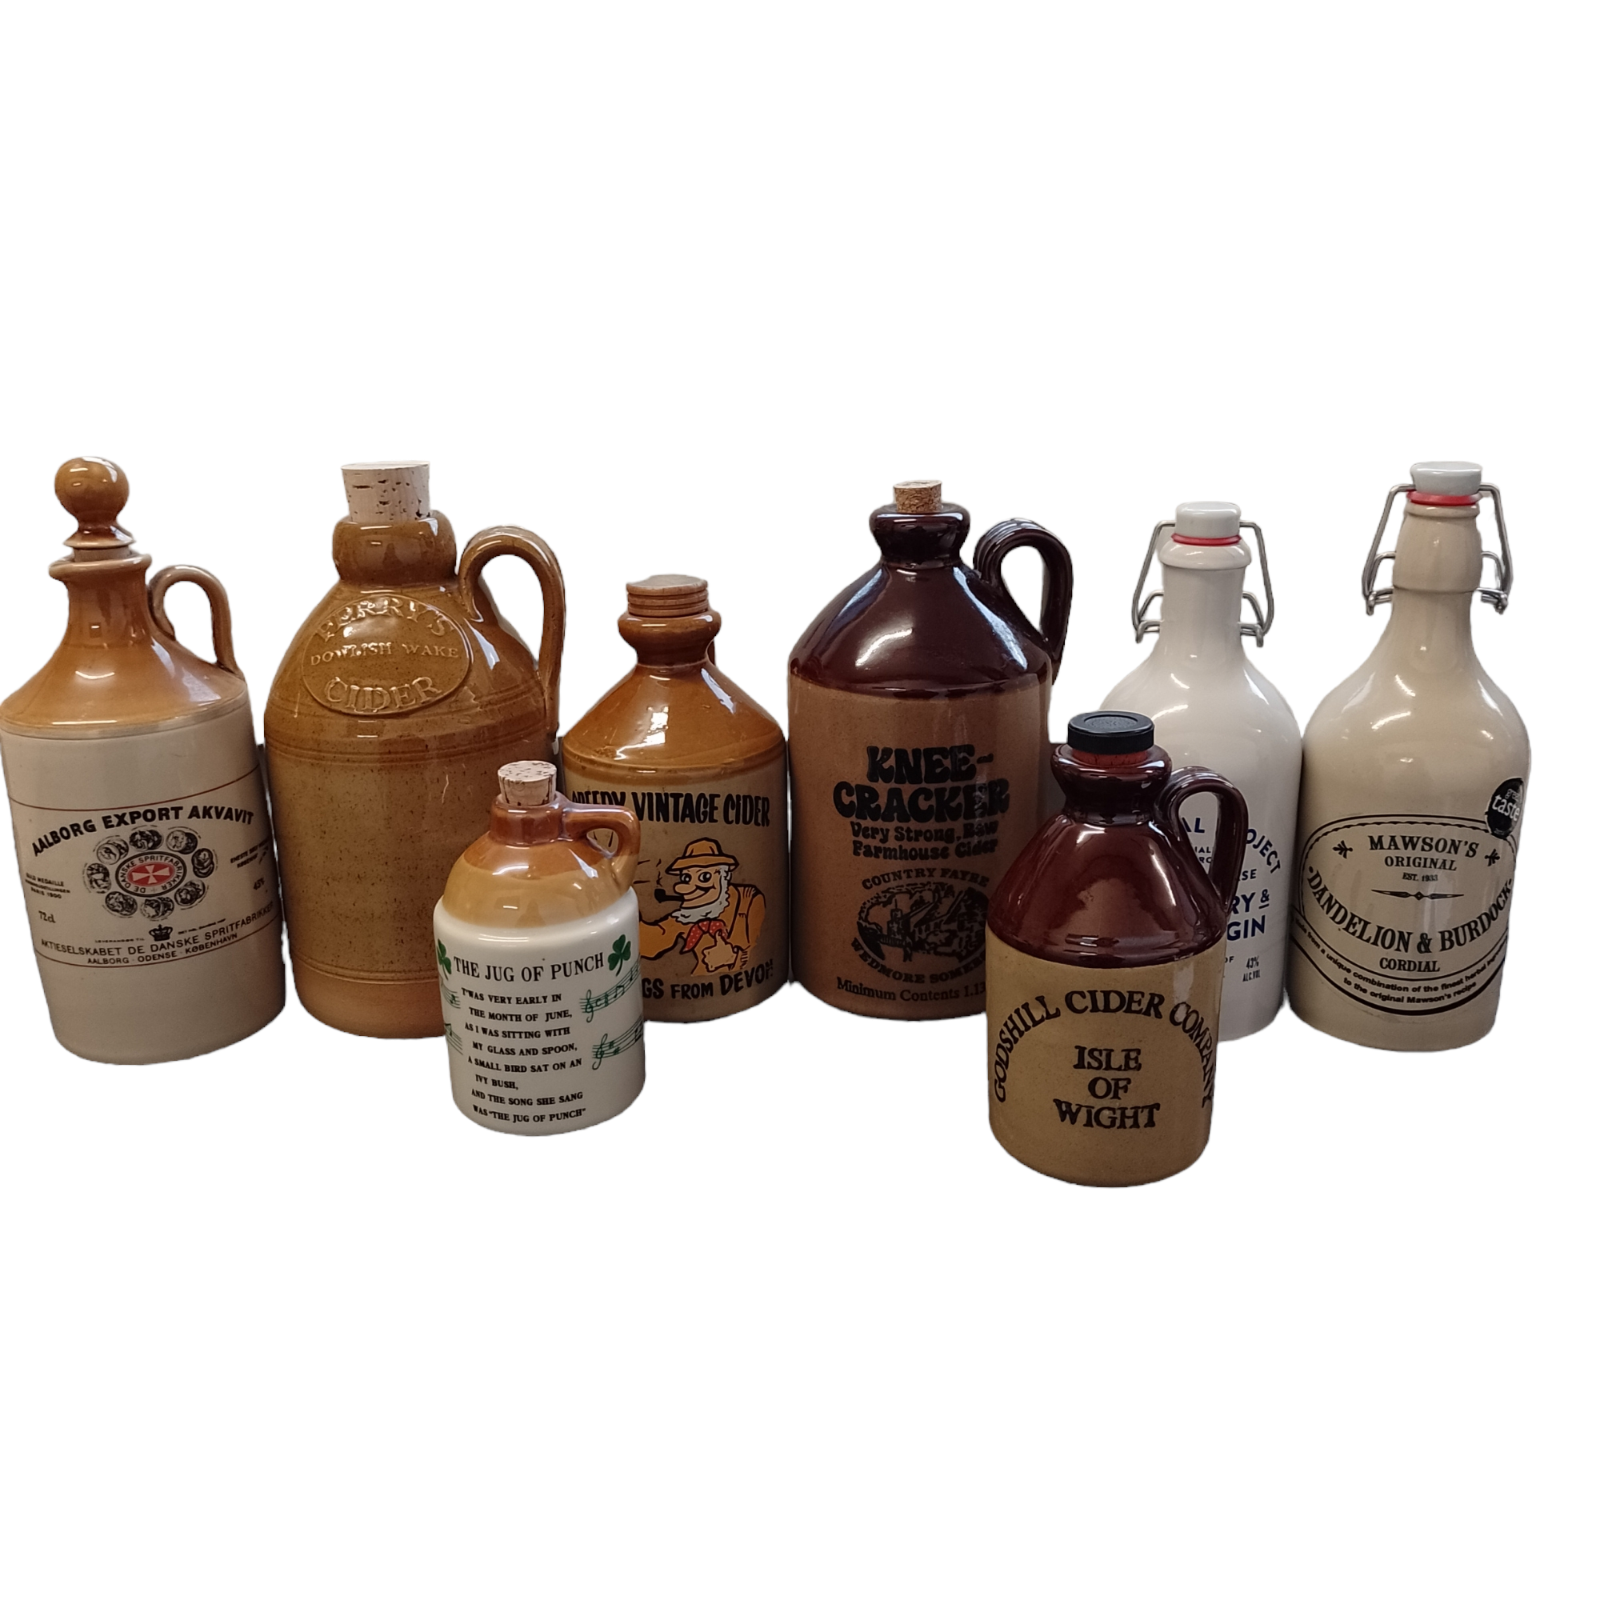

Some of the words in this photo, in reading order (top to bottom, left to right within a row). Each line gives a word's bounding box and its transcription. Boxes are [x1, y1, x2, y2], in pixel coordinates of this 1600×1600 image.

[311, 642, 392, 666] DOWLISH
[402, 643, 459, 658] WAKE
[324, 676, 442, 713] CIDER
[866, 744, 994, 785] KNEE-
[631, 792, 719, 824] VINTAGE
[723, 792, 770, 827] CIDER
[833, 778, 1010, 823] CRACKER
[1492, 795, 1520, 821] taste
[31, 819, 97, 857] AALBORG
[101, 806, 184, 829] EXPORT
[187, 805, 254, 825] AKVAVIT
[850, 821, 890, 844] Very
[852, 840, 949, 861] Farmhouse
[955, 838, 999, 858] Cider
[1246, 828, 1281, 874] OJECT
[1367, 835, 1480, 859] MAWSON'S
[1384, 855, 1457, 871] ORIGINAL
[862, 868, 936, 890] COUNTRY
[940, 868, 990, 887] FAYRE
[1402, 872, 1419, 882] EST.
[1258, 888, 1270, 909] &
[1307, 870, 1414, 953] DANDELION
[1416, 932, 1433, 954] &
[1438, 881, 1512, 952] BURDOCK
[41, 938, 122, 956] AKTIESELSKABET
[128, 945, 145, 955] DE
[150, 935, 200, 953] DANSKE
[87, 957, 129, 965] AALBORG
[137, 951, 178, 963] ODENSE
[185, 933, 238, 955] KØBENHAVN
[454, 956, 480, 978] THE
[485, 965, 514, 982] JUG
[521, 966, 544, 982] OF
[551, 952, 604, 980] PUNCH
[851, 937, 926, 984] WEDMORE
[1379, 957, 1441, 973] CORDIAL
[1326, 953, 1352, 974] unique
[1353, 971, 1409, 993] combination
[1411, 985, 1421, 993] of
[1423, 984, 1439, 993] the
[1441, 978, 1464, 990] finest
[1465, 963, 1487, 982] herbal
[461, 988, 485, 1001] T'WAS
[488, 994, 512, 1005] VERY
[515, 995, 548, 1005] EARLY
[552, 994, 562, 1002] IN
[670, 982, 713, 1000] FROM
[836, 976, 897, 1001] Minimum
[900, 989, 960, 1001] Contents
[1343, 977, 1352, 986] to
[1354, 983, 1368, 994] the
[1370, 989, 1404, 1003] original
[1406, 991, 1452, 1004] Mawson's
[469, 1007, 485, 1018] THE
[488, 1012, 522, 1022] MONTH
[525, 1014, 539, 1022] OF
[545, 1010, 572, 1022] JUNE,
[464, 1022, 474, 1031] AS
[475, 1025, 479, 1033] I
[481, 1027, 499, 1038] WAS
[502, 1030, 541, 1039] SITTING
[544, 1027, 571, 1038] WITH
[472, 1041, 483, 1051] MY
[487, 1045, 516, 1056] GLASS
[519, 1047, 539, 1056] AND
[541, 1043, 578, 1055] SPOON,
[994, 995, 1061, 1103] GODSHILL
[1065, 990, 1165, 1019] CIDER
[1169, 1001, 1216, 1108] COMPANY
[1073, 1045, 1142, 1072] ISLE
[468, 1056, 473, 1064] A
[474, 1058, 502, 1071] SMALL
[504, 1064, 528, 1073] BIRD
[530, 1064, 549, 1072] SAT
[552, 1061, 566, 1071] ON
[569, 1058, 582, 1068] AN
[475, 1074, 488, 1085] IVY
[491, 1079, 519, 1090] BUSH,
[1087, 1076, 1132, 1100] OF
[471, 1089, 486, 1100] AND
[488, 1094, 505, 1105] THE
[508, 1097, 533, 1106] SONG
[536, 1097, 556, 1106] SHE
[559, 1091, 583, 1104] SANG
[472, 1105, 488, 1117] WAS
[513, 1114, 530, 1123] JUG
[533, 1114, 546, 1123] OF
[1053, 1098, 1161, 1129] WIGHT
